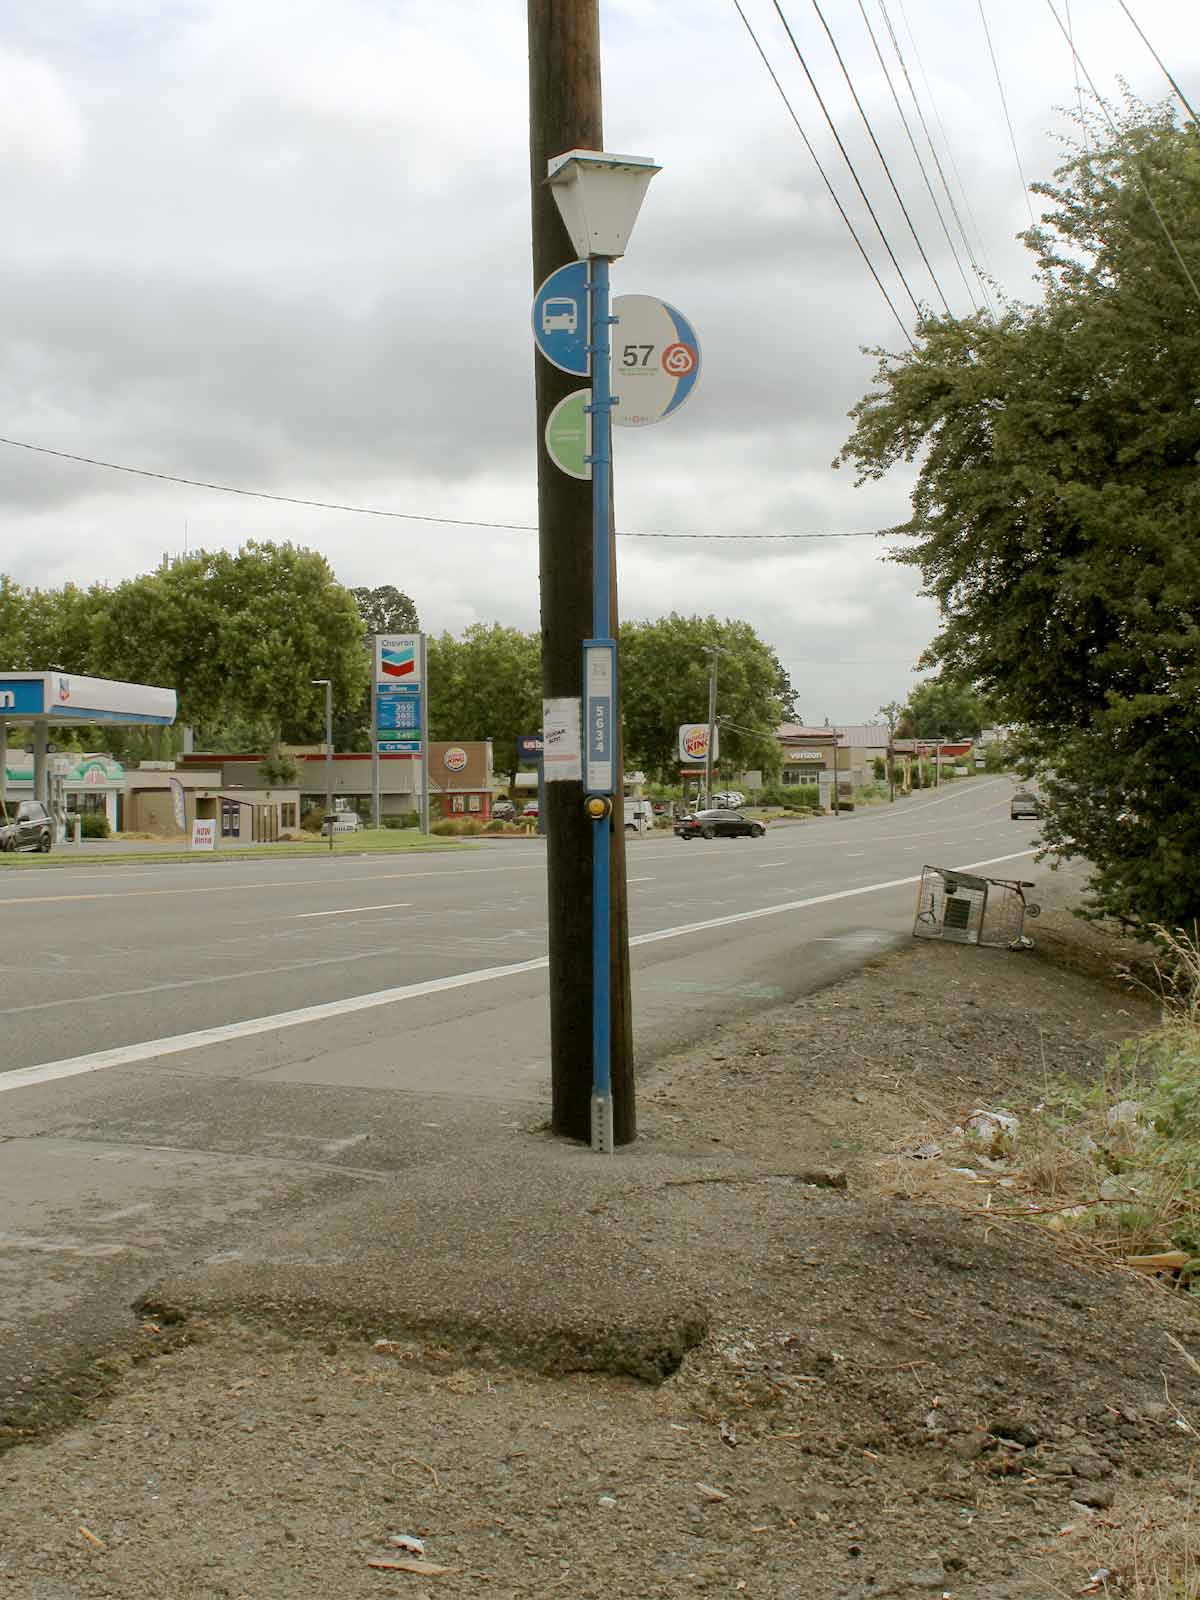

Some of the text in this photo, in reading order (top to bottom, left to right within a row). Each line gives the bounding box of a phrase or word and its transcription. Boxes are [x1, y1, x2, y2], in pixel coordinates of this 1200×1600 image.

[623, 345, 655, 366] 57
[381, 639, 414, 647] Chevron
[789, 750, 822, 759] verizon
